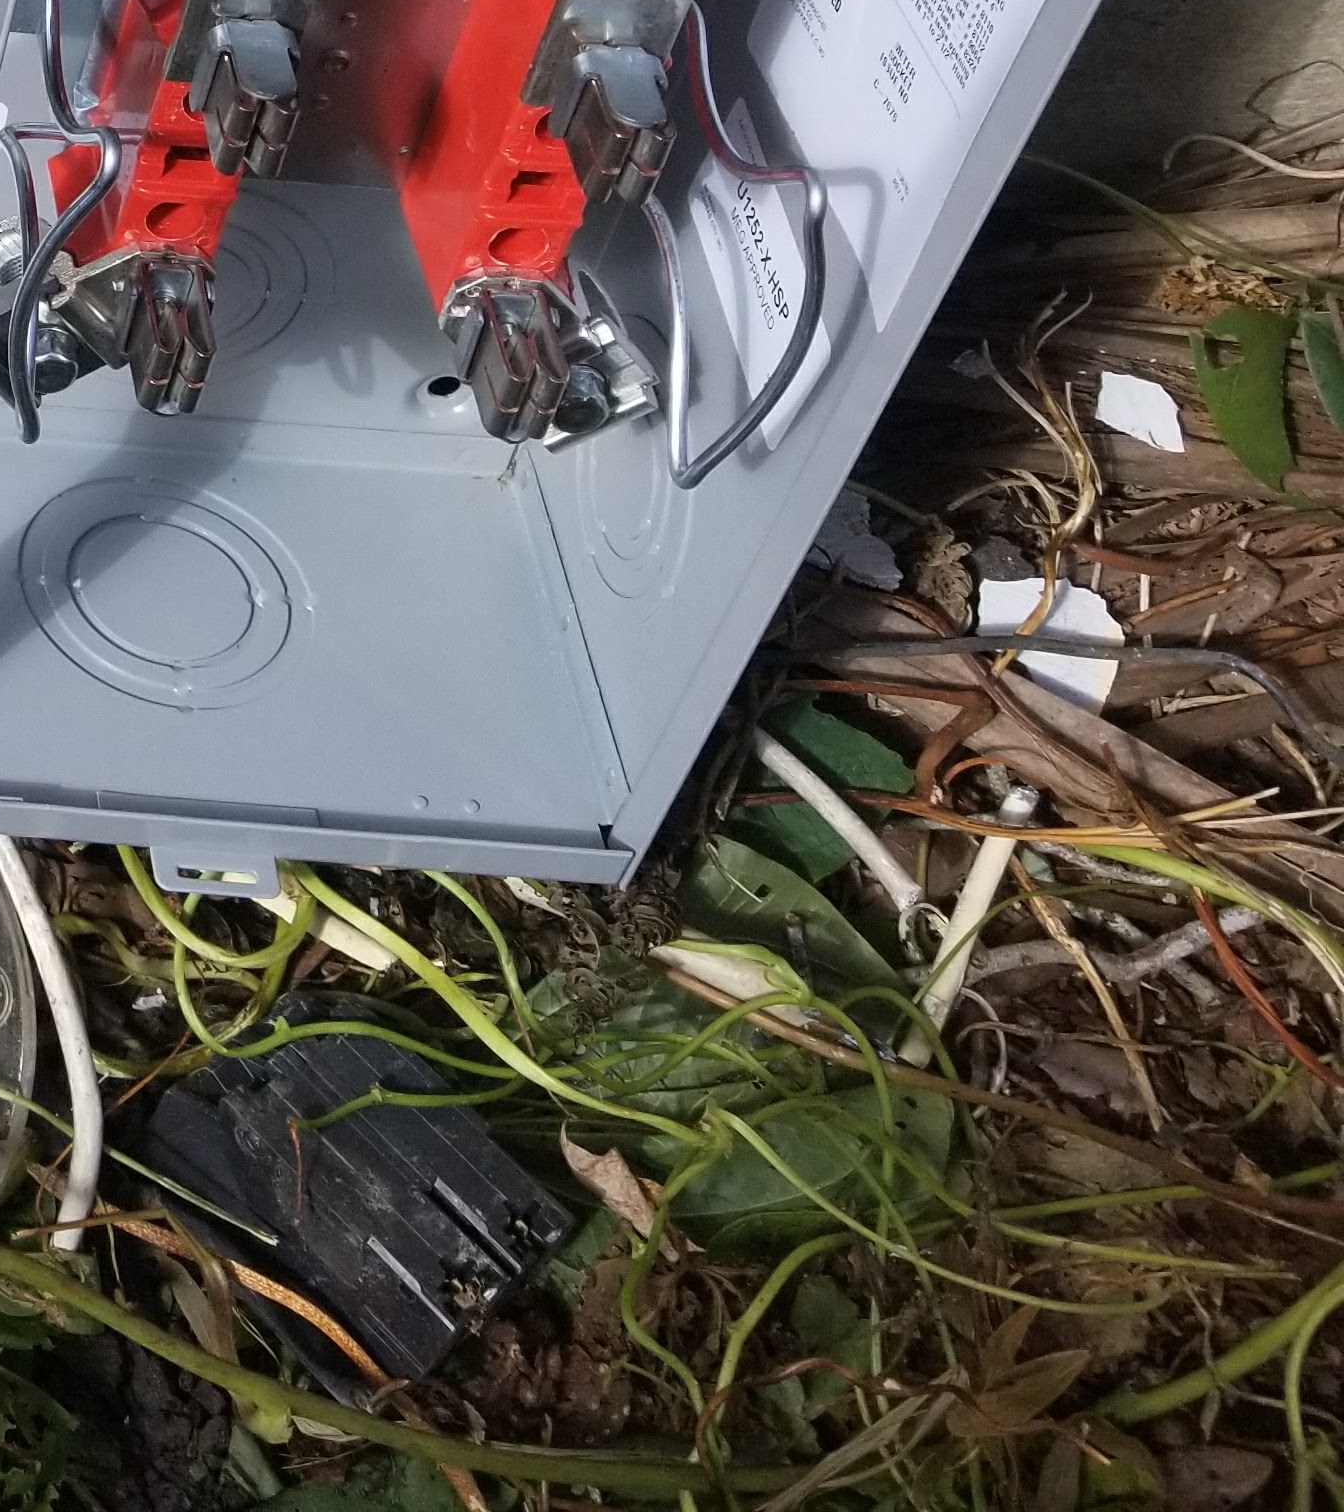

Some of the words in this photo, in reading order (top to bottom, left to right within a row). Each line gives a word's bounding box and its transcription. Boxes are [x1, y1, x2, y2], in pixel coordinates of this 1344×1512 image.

[879, 50, 899, 88] ISSUE
[737, 181, 790, 320] U1252-X-HSP
[742, 246, 775, 330] APPROVED
